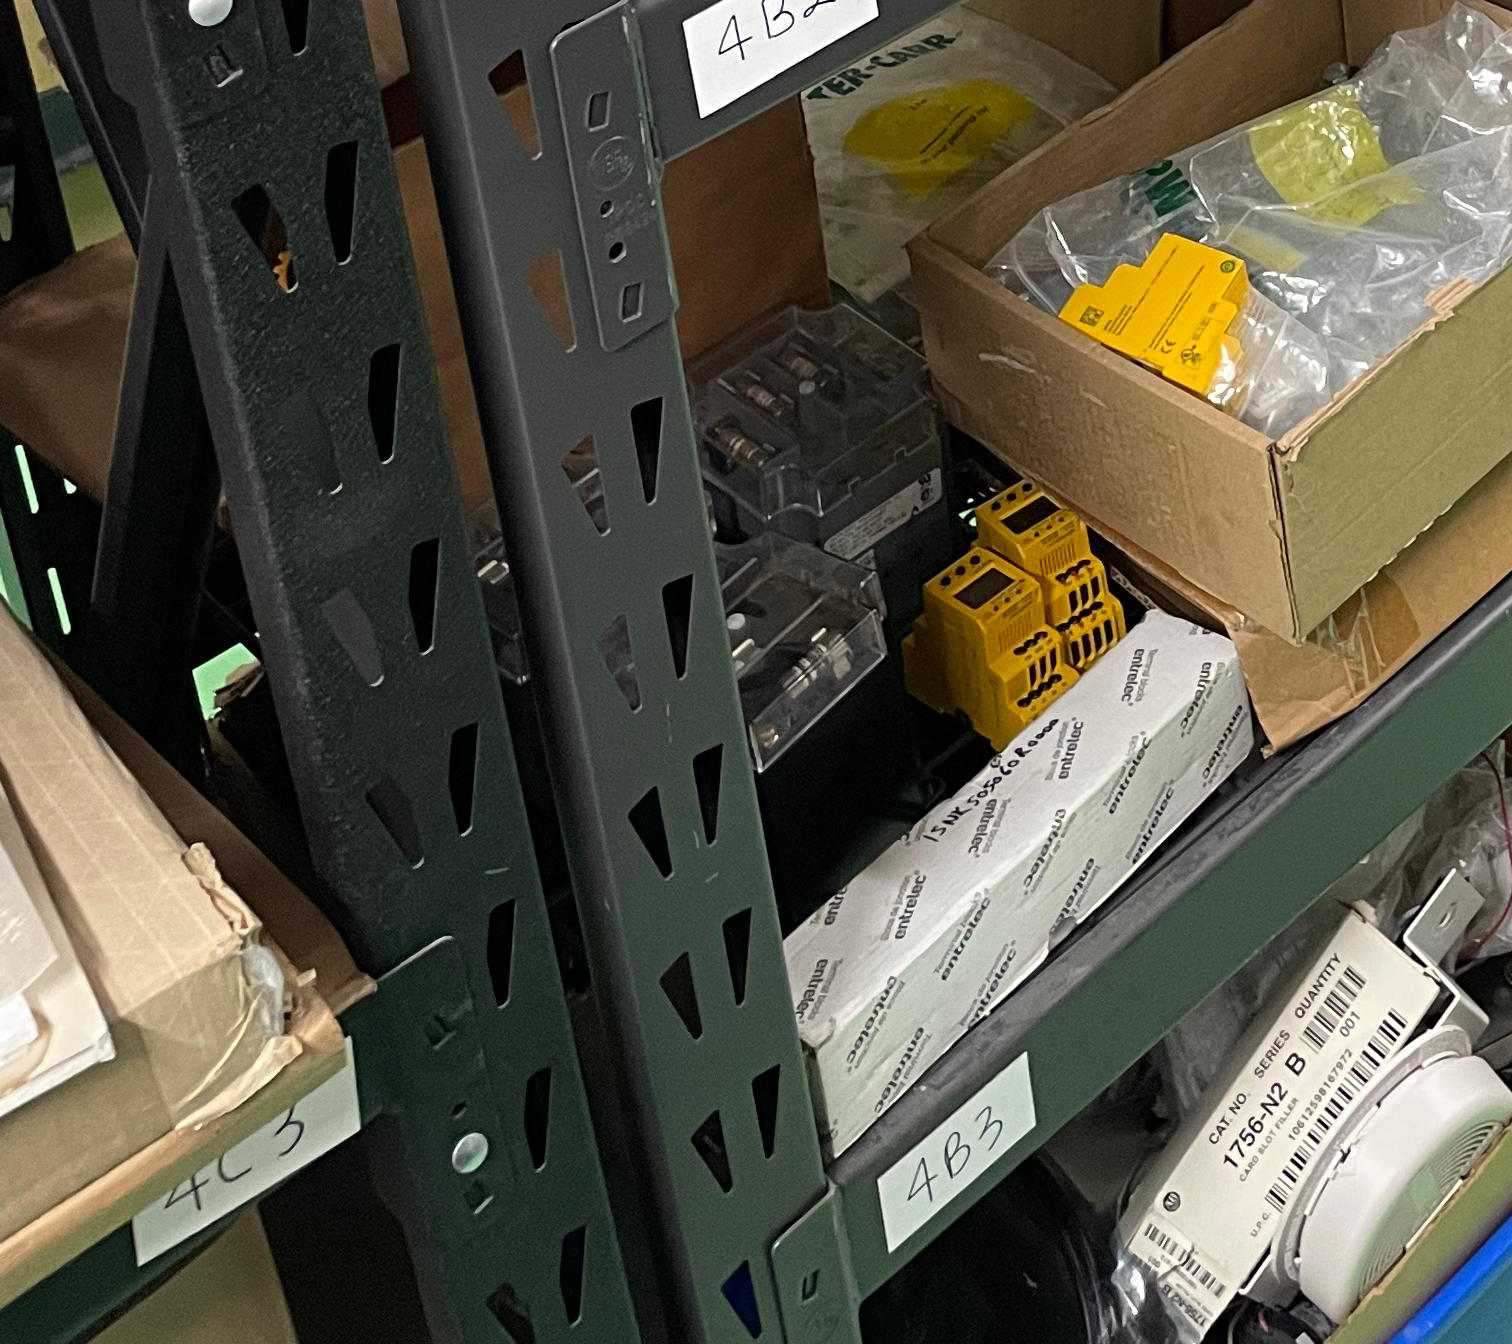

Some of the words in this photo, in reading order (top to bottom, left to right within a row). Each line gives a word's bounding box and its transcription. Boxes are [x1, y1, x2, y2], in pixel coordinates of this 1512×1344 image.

[894, 874, 927, 940] entrelec
[1294, 952, 1342, 1019] QUANTITY
[1254, 1029, 1291, 1081] SERIES
[1338, 1011, 1361, 1038] 001
[1285, 1052, 1306, 1077] B
[1209, 1116, 1234, 1145] CAT.
[1230, 1092, 1251, 1116] NO.
[1222, 1081, 1289, 1170] 1756-N2
[1239, 1155, 1260, 1182] CARD
[1258, 1125, 1279, 1155] SLOT
[1274, 1097, 1299, 1130] FILLER
[907, 1106, 1003, 1202] 4B3
